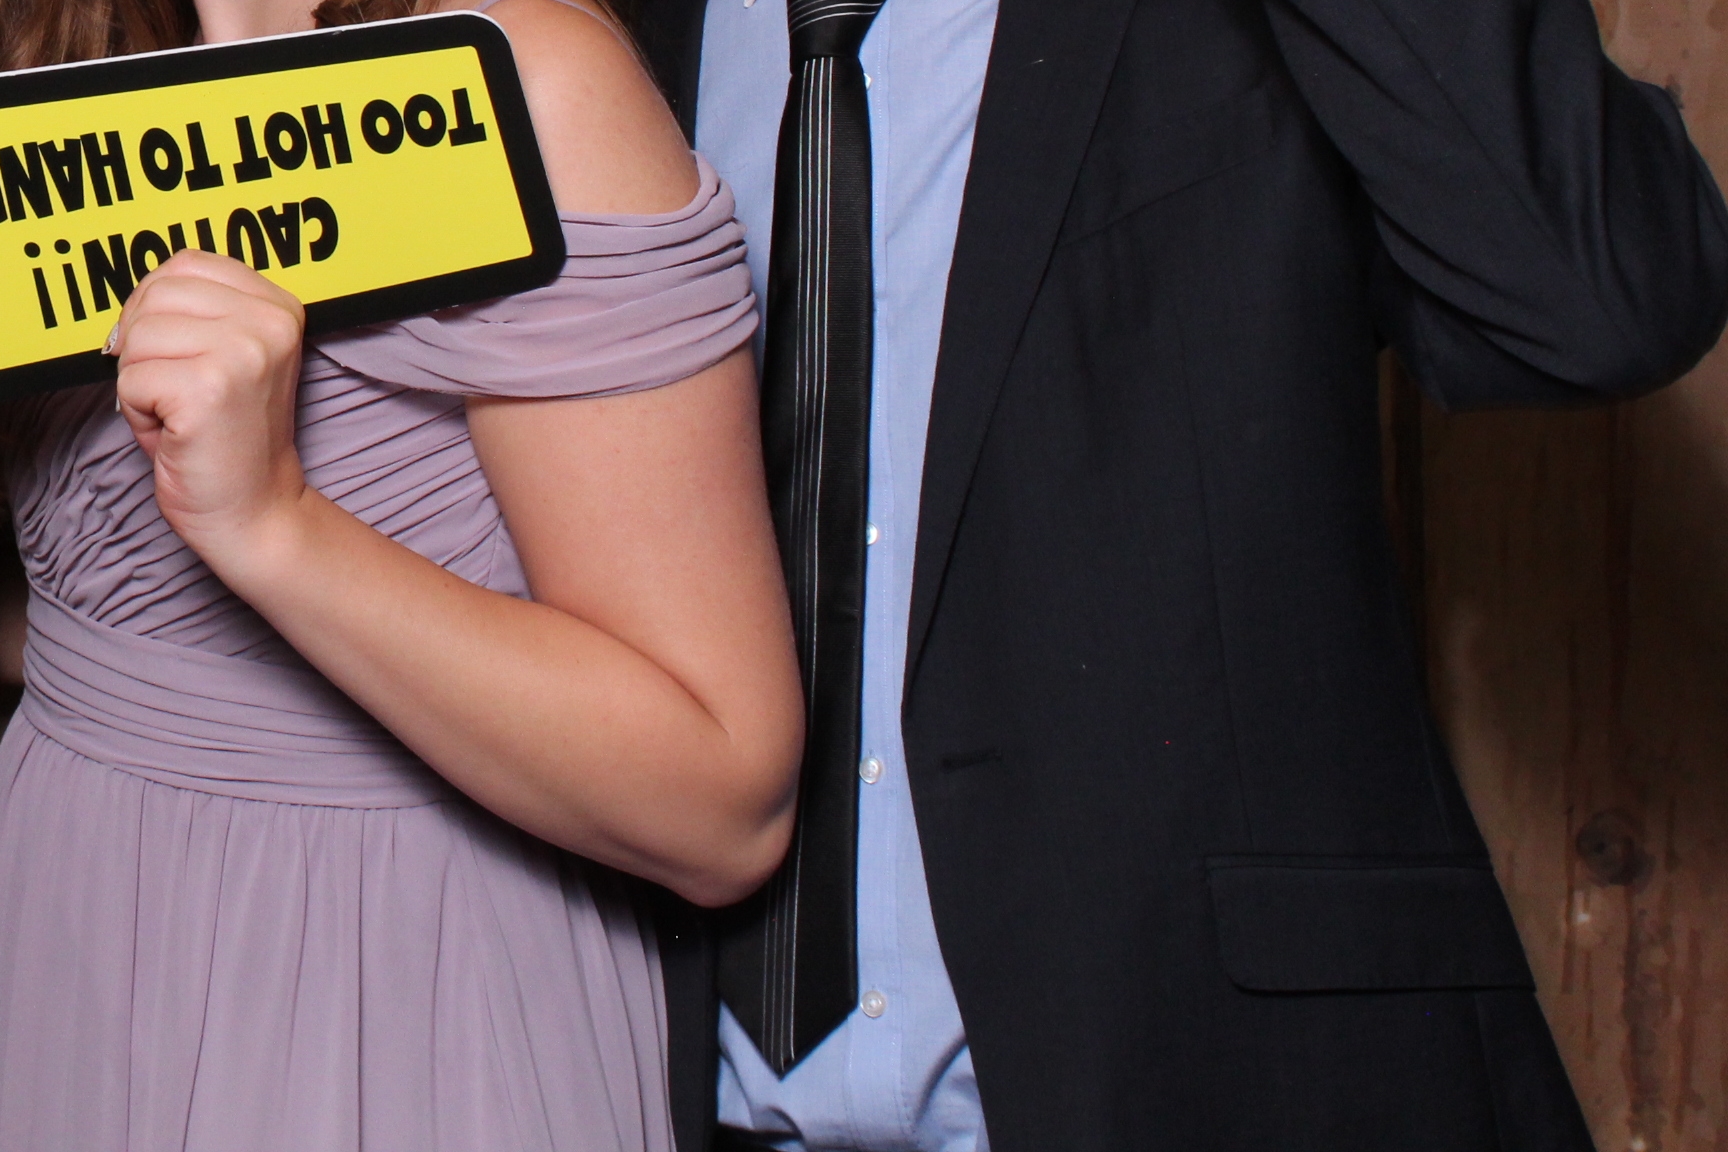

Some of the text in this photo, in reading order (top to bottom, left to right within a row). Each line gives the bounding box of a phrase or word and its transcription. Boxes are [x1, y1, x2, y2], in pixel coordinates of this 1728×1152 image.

[139, 121, 223, 192] TO
[233, 102, 352, 184] HOT
[361, 87, 486, 155] TOO
